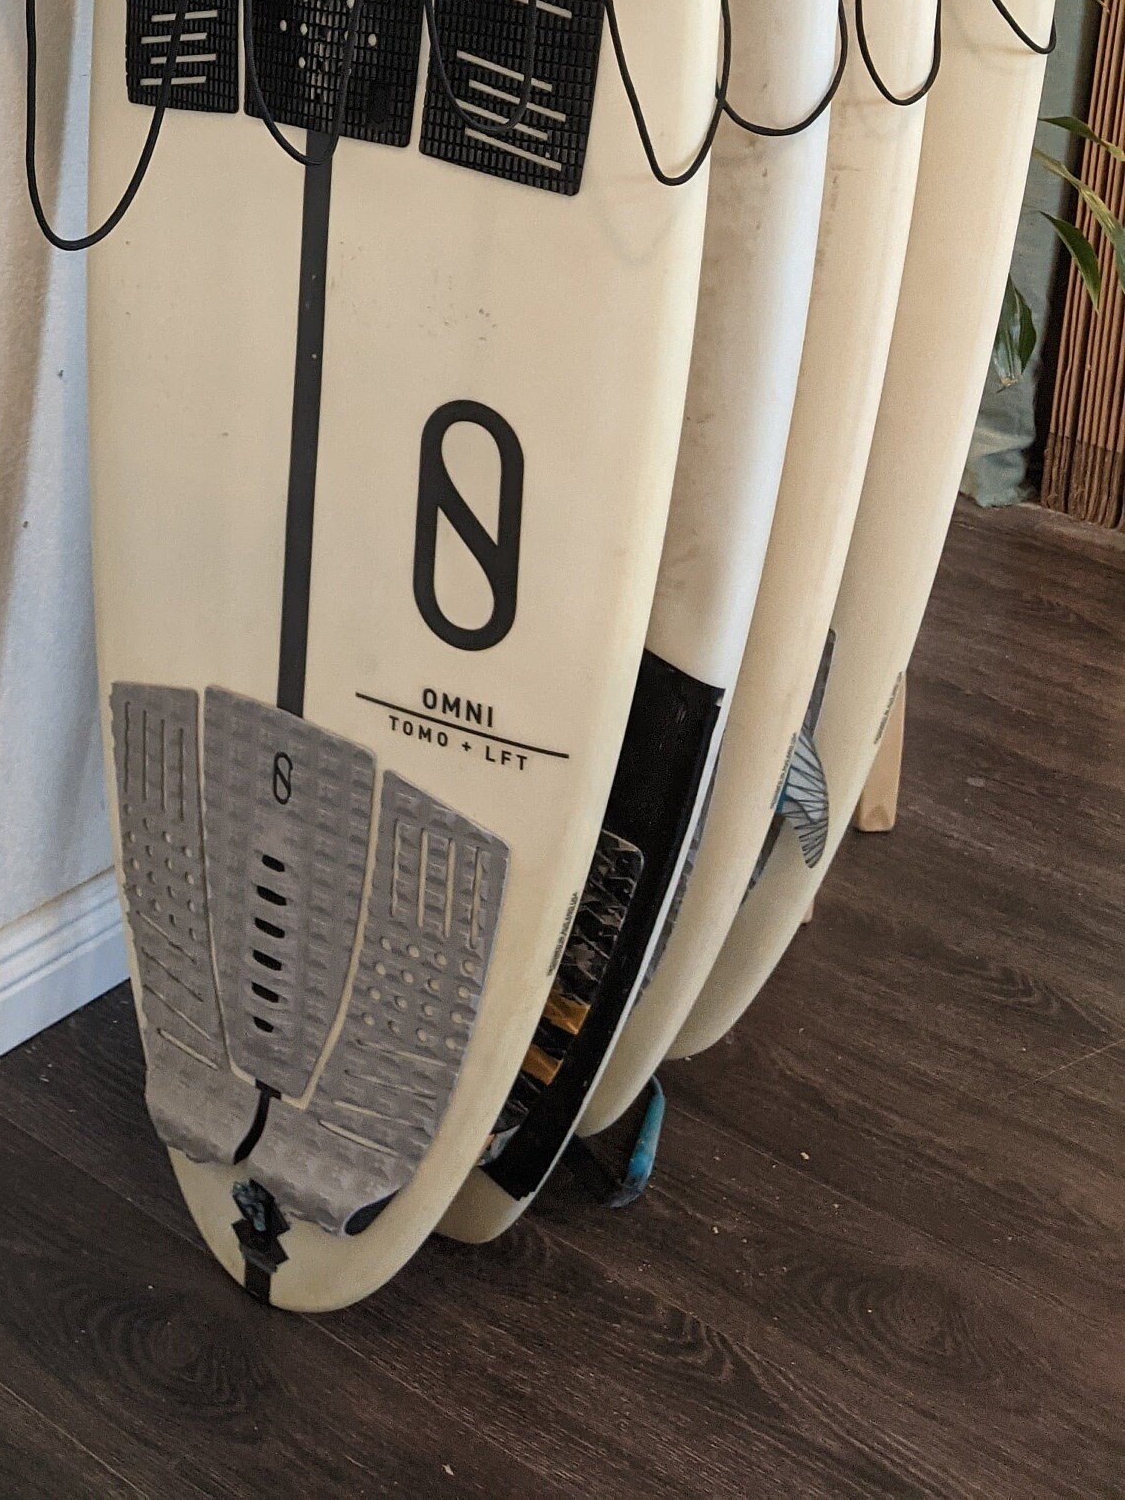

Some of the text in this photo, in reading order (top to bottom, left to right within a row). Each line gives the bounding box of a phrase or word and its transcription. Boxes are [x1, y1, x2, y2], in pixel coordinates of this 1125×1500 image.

[422, 687, 494, 728] OMNI
[388, 714, 449, 747] TOMO
[485, 745, 528, 771] LFT
